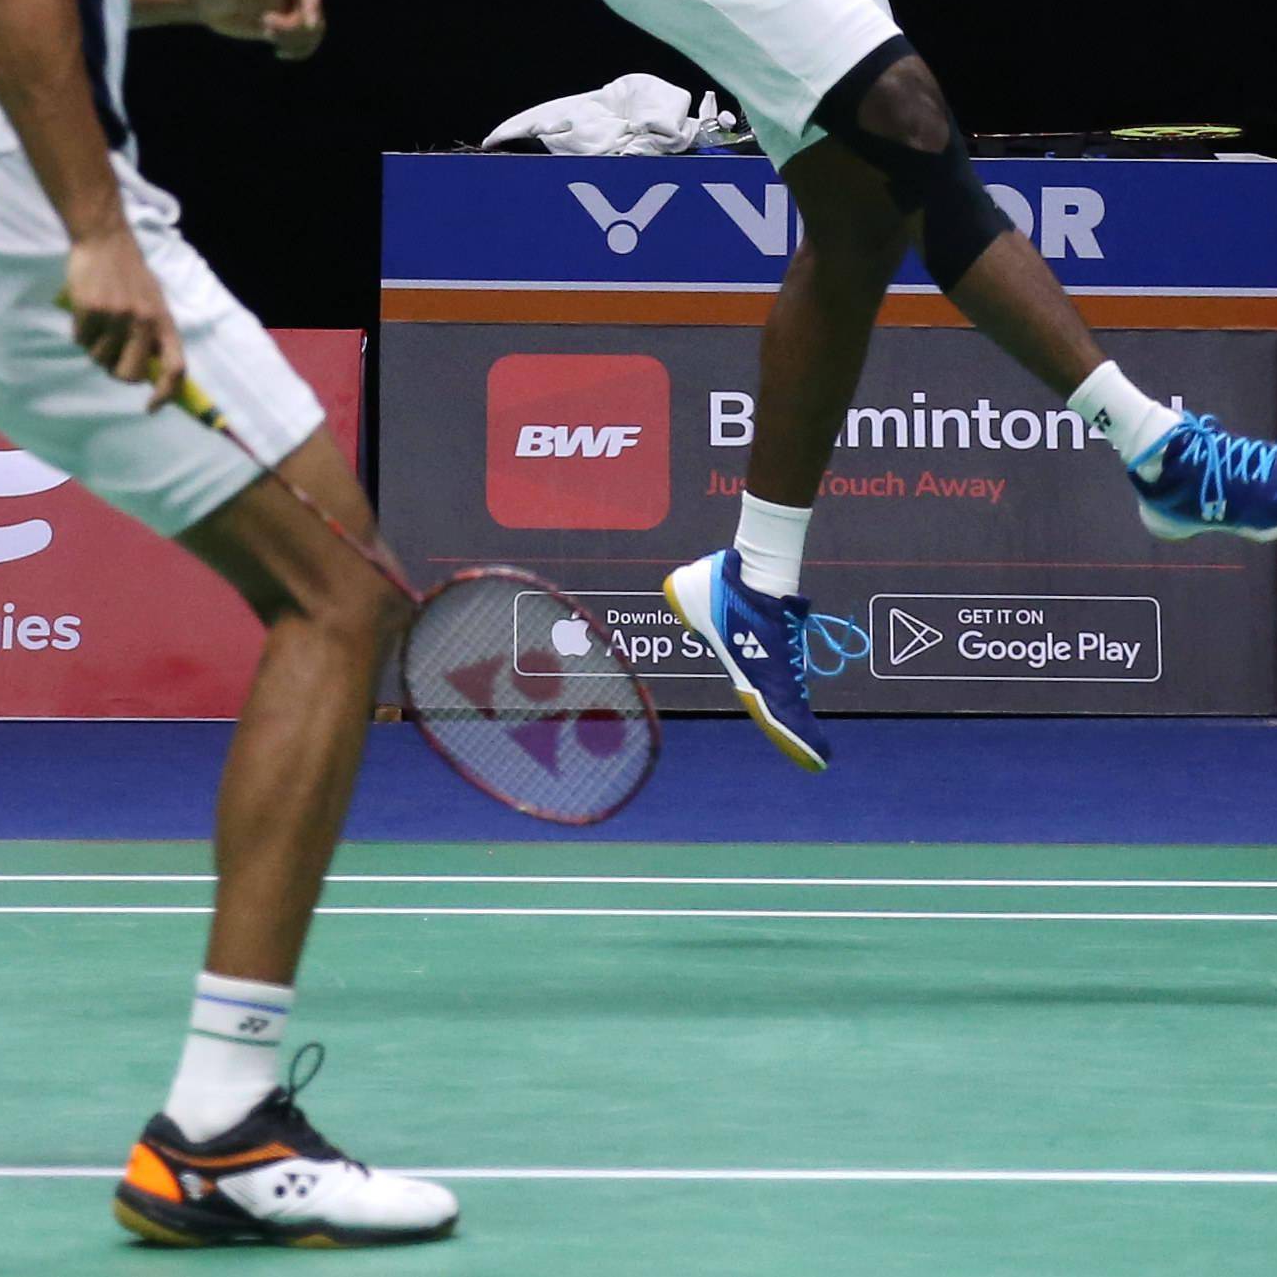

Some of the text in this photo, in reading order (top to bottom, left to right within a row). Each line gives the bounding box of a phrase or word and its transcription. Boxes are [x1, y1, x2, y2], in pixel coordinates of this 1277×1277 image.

[514, 425, 643, 458] BWF
[916, 472, 1006, 503] Away
[606, 609, 683, 625] Downloa
[957, 609, 1044, 625] GET IT ON
[605, 629, 673, 664] App
[957, 630, 1141, 669] Google Play
